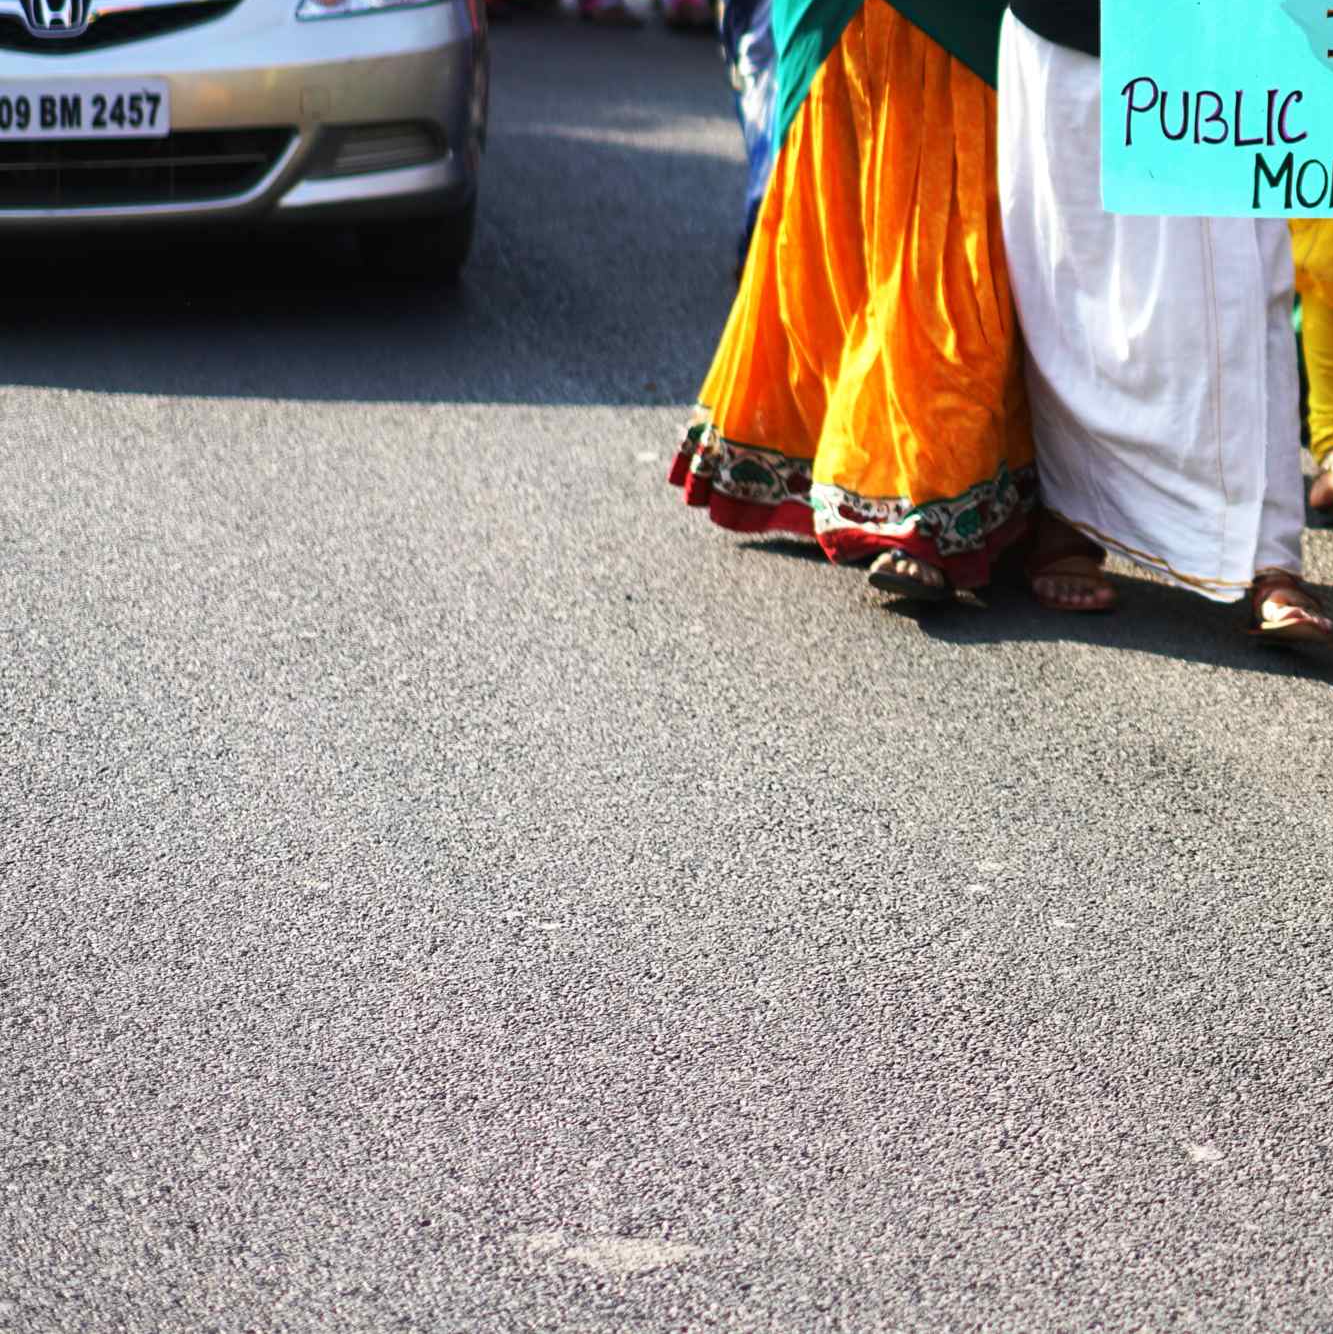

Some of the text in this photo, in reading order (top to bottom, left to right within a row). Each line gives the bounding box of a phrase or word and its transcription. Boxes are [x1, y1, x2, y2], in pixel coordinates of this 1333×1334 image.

[40, 93, 82, 129] BM
[91, 90, 161, 129] 2457
[1120, 76, 1308, 147] PUBLIC
